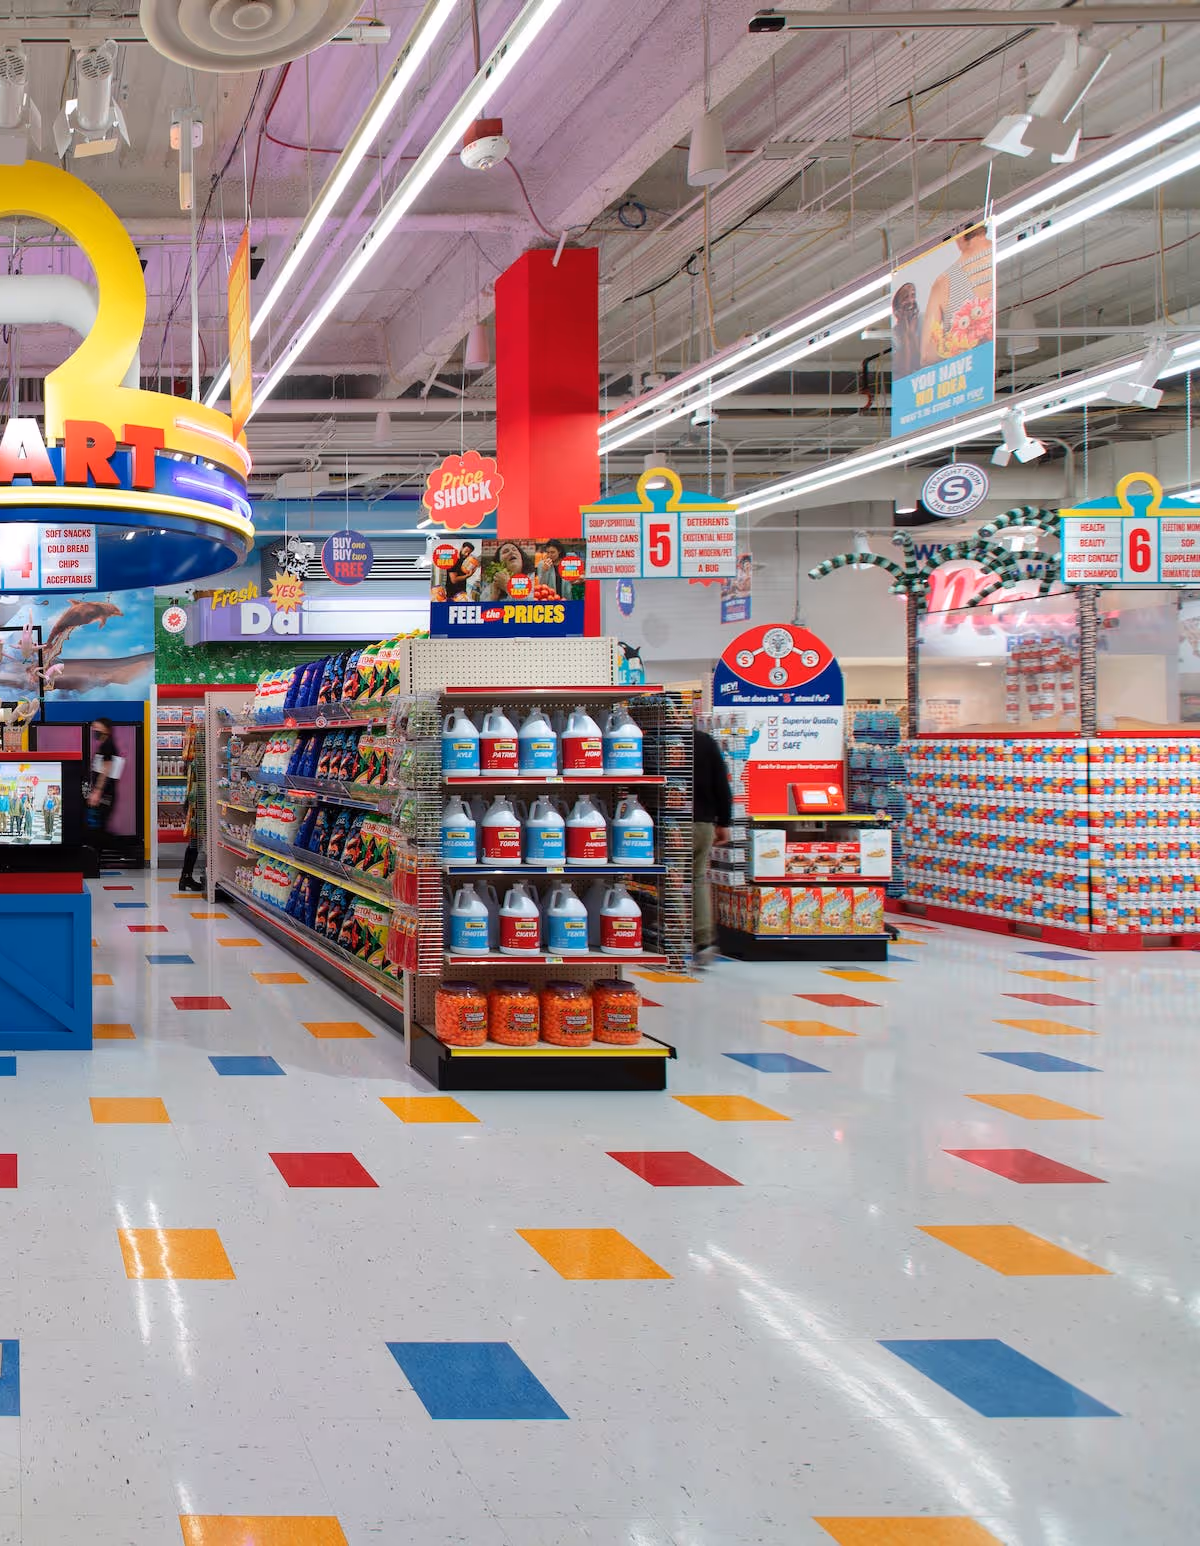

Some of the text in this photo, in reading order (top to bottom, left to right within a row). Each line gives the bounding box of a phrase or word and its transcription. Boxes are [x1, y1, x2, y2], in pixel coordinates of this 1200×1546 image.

[912, 370, 936, 394] YOU
[937, 374, 968, 400] IDEA
[441, 469, 484, 490] Price
[928, 468, 982, 494] STRAIGHT FROM
[944, 478, 966, 501] S
[434, 480, 492, 510] SHOCK
[930, 494, 979, 513] THE SOURCE
[686, 518, 730, 527] DETERRENTS
[1080, 524, 1105, 532] HEALTH
[46, 529, 91, 538] SOFT SNACKS
[588, 534, 639, 543] JAMMED CANS
[332, 536, 366, 550] BUY one
[649, 523, 671, 568] 5
[1080, 539, 1106, 547] BEAUTY
[48, 544, 89, 553] COLD BREAD
[1129, 528, 1151, 573] 6
[333, 548, 367, 561] BUY two
[591, 550, 635, 559] EMPTY CANS
[1067, 554, 1119, 563] FIRST CONTACT
[58, 560, 80, 568] CHIPS
[698, 564, 719, 573] A BUG
[334, 562, 365, 578] FREE
[590, 565, 614, 574] CANNED
[46, 575, 92, 585] ACCEPTABLES
[211, 581, 259, 611] Fresh
[275, 584, 297, 598] YES
[510, 588, 529, 596] TASTE
[449, 604, 566, 625] FEEL the PRICES
[720, 682, 739, 693] HEY!
[732, 695, 751, 703] What
[751, 695, 767, 703] does
[767, 695, 779, 703] the
[795, 694, 815, 703] stand
[815, 694, 831, 703] for?
[782, 717, 839, 726] Superior Quality
[782, 730, 819, 739] Satisfying
[782, 742, 801, 750] SAFE
